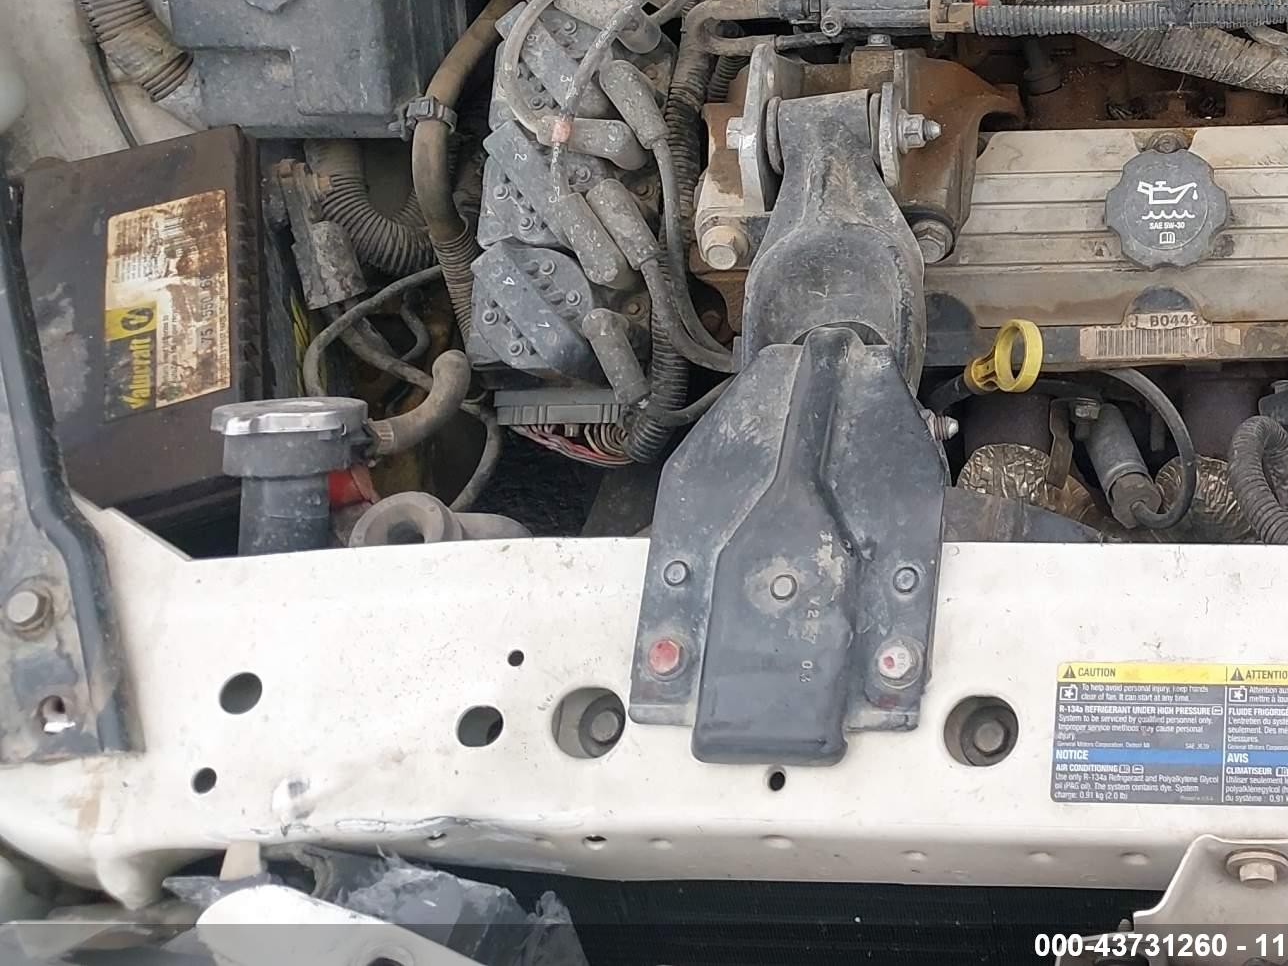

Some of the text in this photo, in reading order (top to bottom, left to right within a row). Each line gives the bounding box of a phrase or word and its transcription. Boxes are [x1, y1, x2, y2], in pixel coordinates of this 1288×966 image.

[514, 153, 528, 161] 2
[1164, 221, 1186, 230] 5W-30
[502, 276, 516, 286] 4
[200, 296, 213, 319] 550
[200, 328, 214, 343] 75
[1078, 667, 1115, 676] CAUTION
[1228, 707, 1251, 716] FLUIDE
[1059, 714, 1213, 723] System to be serviced by qualified personnel only.
[1056, 750, 1088, 760] NOTICE
[1227, 753, 1248, 763] AVIS
[1056, 764, 1068, 772] AIR
[1226, 767, 1272, 775] CLIMATISEUR
